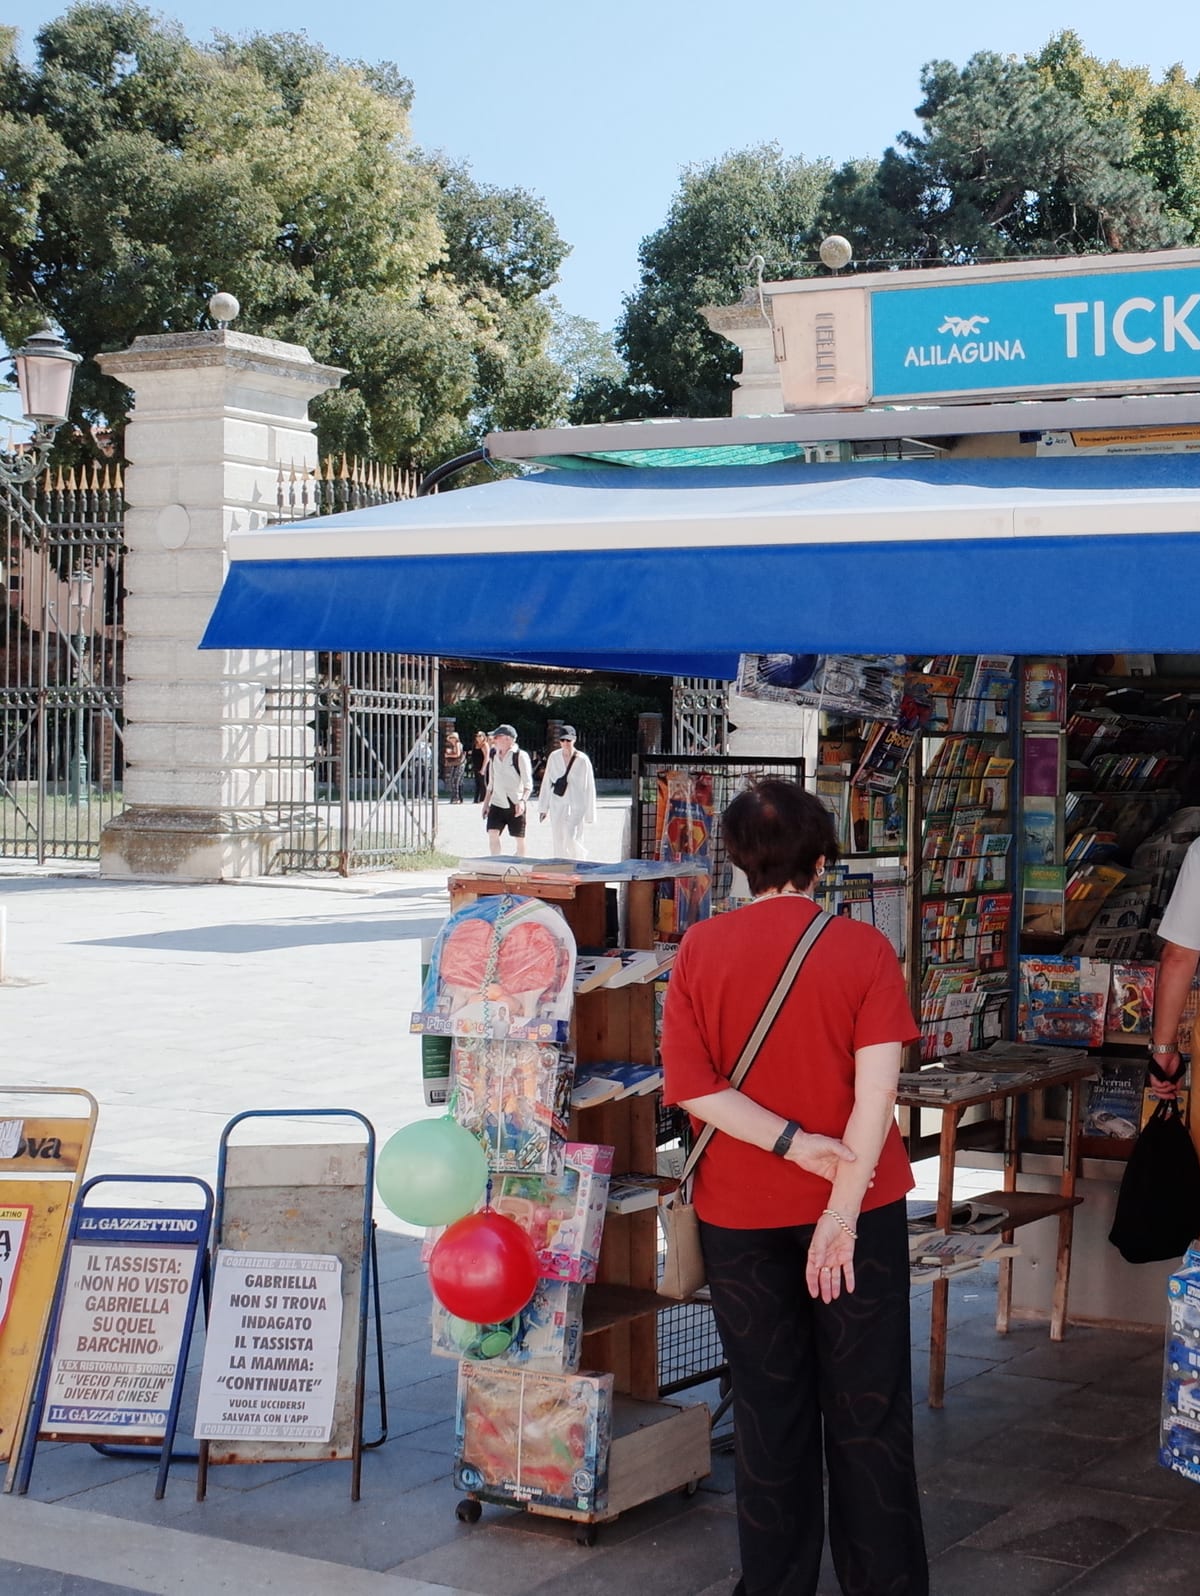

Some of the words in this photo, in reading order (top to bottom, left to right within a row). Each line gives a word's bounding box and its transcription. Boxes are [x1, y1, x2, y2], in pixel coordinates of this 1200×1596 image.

[904, 339, 1026, 367] ALILAGUNA
[426, 1015, 452, 1034] Ping
[0, 1210, 22, 1218] ATINO
[80, 1218, 98, 1230] IL
[99, 1218, 198, 1232] GAZZETTINO
[87, 1255, 102, 1272] IL
[104, 1255, 182, 1274] TASSISTA:
[225, 1256, 276, 1268] CORRIERE
[278, 1257, 297, 1269] DEL
[300, 1259, 336, 1271] VENETO
[116, 1276, 140, 1293] HO
[144, 1277, 189, 1295] VISTO
[244, 1274, 317, 1290] GABRIELLA
[85, 1295, 170, 1315] GABRIELLA
[229, 1293, 261, 1309] NON
[264, 1295, 278, 1309] SI
[281, 1296, 327, 1311] TROVA
[92, 1316, 114, 1333] SU
[115, 1317, 157, 1336] QUEL
[241, 1315, 312, 1331] INDAGATO
[234, 1335, 247, 1349] IL
[252, 1336, 313, 1351] TASSISTA
[80, 1360, 134, 1374] RISTORANTE
[135, 1362, 174, 1375] STORICO
[229, 1355, 246, 1369] LA
[250, 1356, 315, 1372] MAMMA:
[55, 1373, 65, 1385] IL
[64, 1387, 114, 1401] DIVENTA
[116, 1388, 160, 1403] CINESE
[228, 1399, 258, 1409] VUOLE
[260, 1399, 306, 1410] UCCIDERSI
[51, 1407, 68, 1420] IL
[68, 1408, 166, 1425] GAZZETTINO
[222, 1412, 261, 1423] SALVATA
[263, 1412, 281, 1423] CON
[284, 1413, 309, 1424] L'APP
[203, 1423, 258, 1434] CORRIERE
[259, 1424, 279, 1436] DEL
[282, 1426, 323, 1438] VENETO
